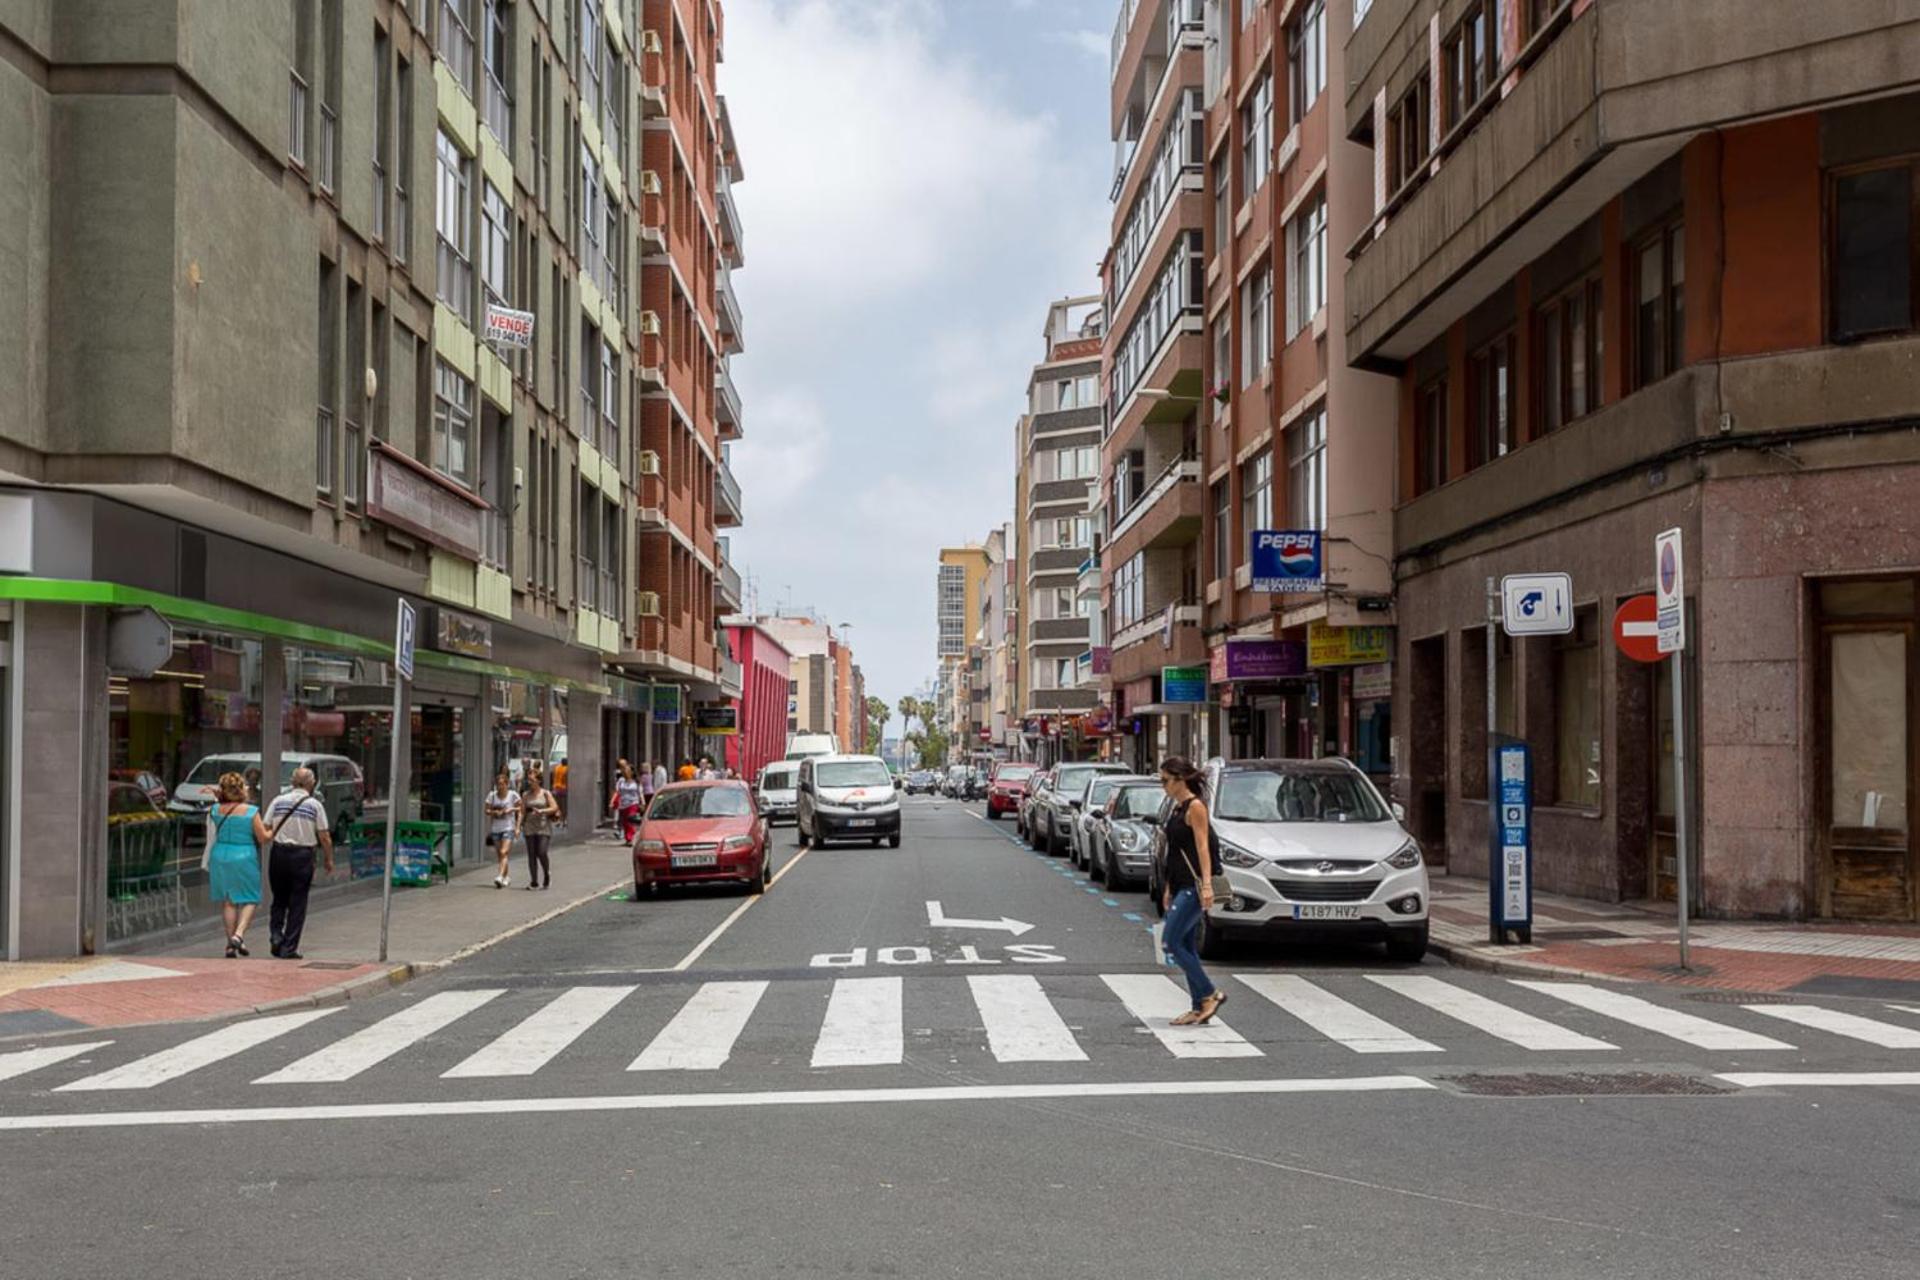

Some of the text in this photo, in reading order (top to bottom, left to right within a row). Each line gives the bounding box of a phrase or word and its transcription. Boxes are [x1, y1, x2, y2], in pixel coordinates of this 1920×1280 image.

[490, 314, 530, 334] VENDE
[1258, 534, 1316, 549] PEPSI
[402, 607, 412, 658] P
[1302, 905, 1359, 918] 4187 HVZ
[809, 945, 1067, 967] STOP
